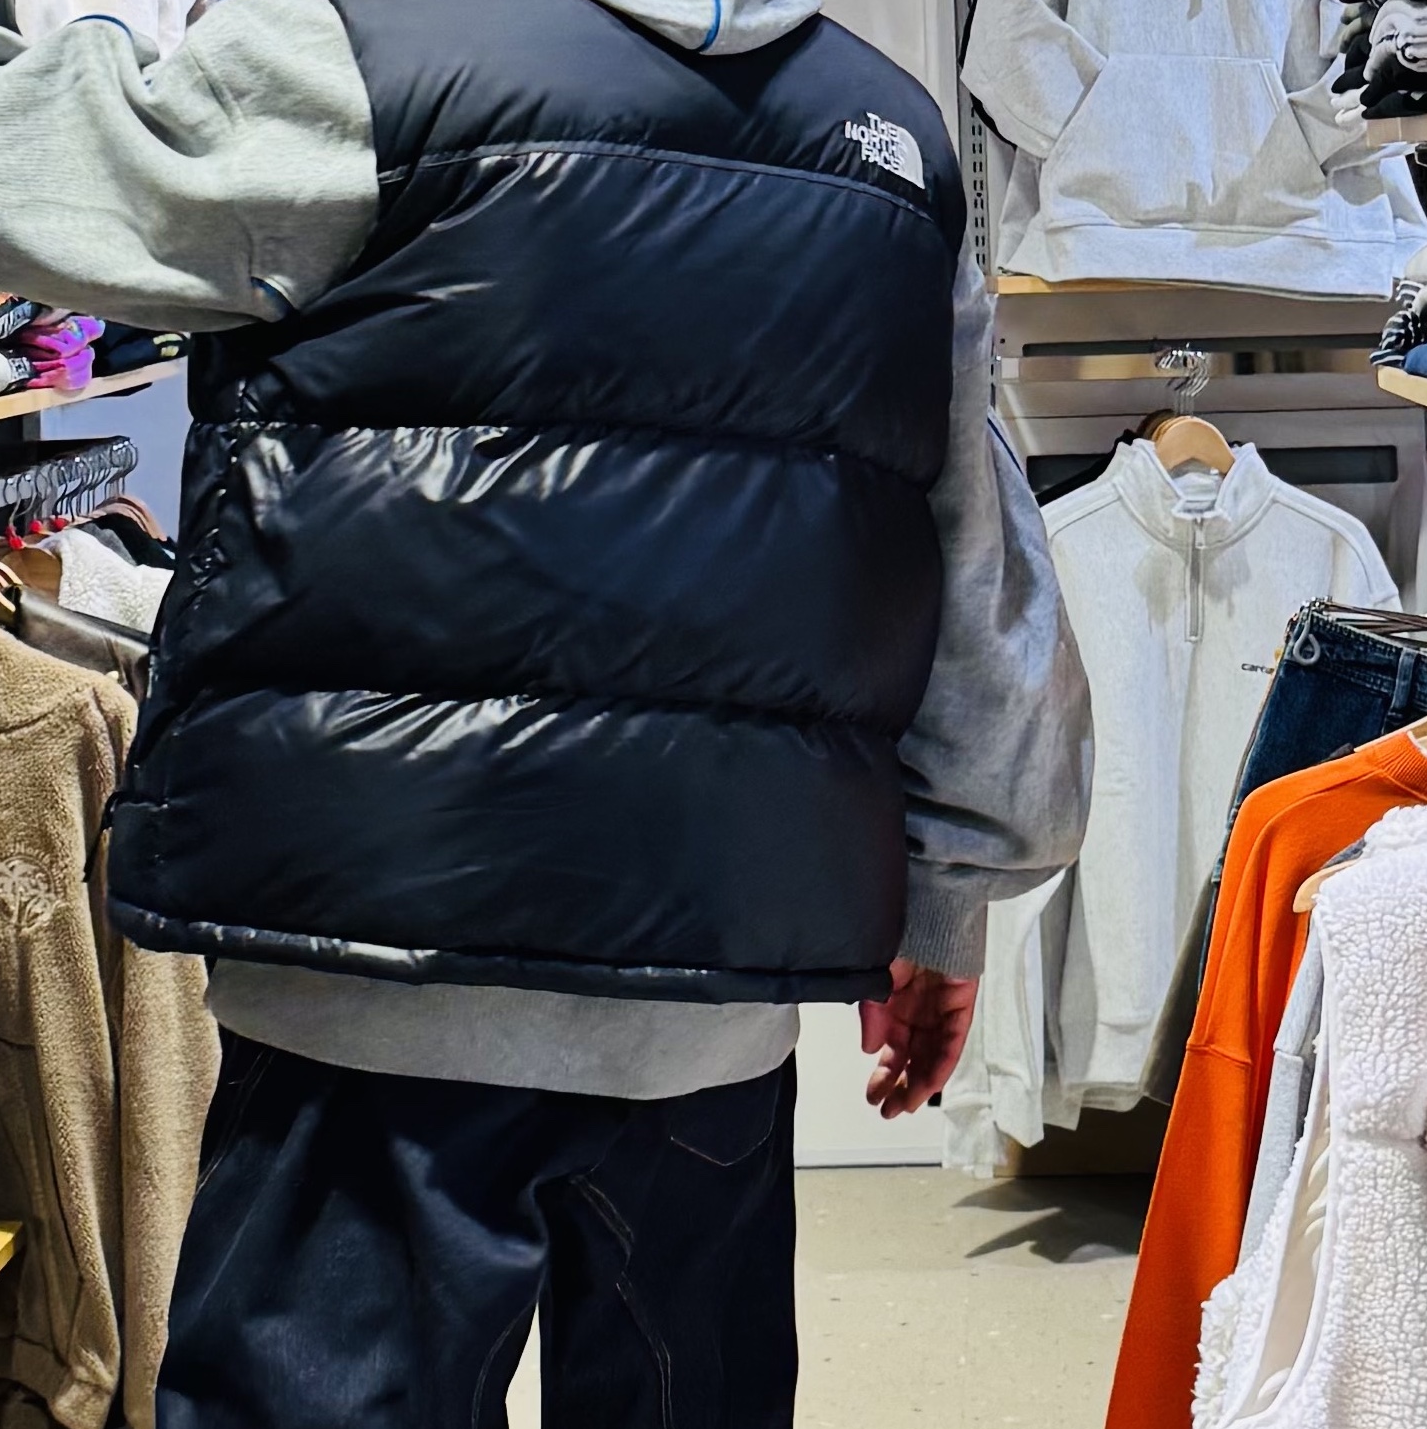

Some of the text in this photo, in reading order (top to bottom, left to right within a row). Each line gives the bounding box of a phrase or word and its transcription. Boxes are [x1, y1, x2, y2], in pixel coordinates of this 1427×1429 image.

[844, 121, 899, 158] NORTH
[866, 112, 899, 143] THE
[861, 143, 901, 172] FACE
